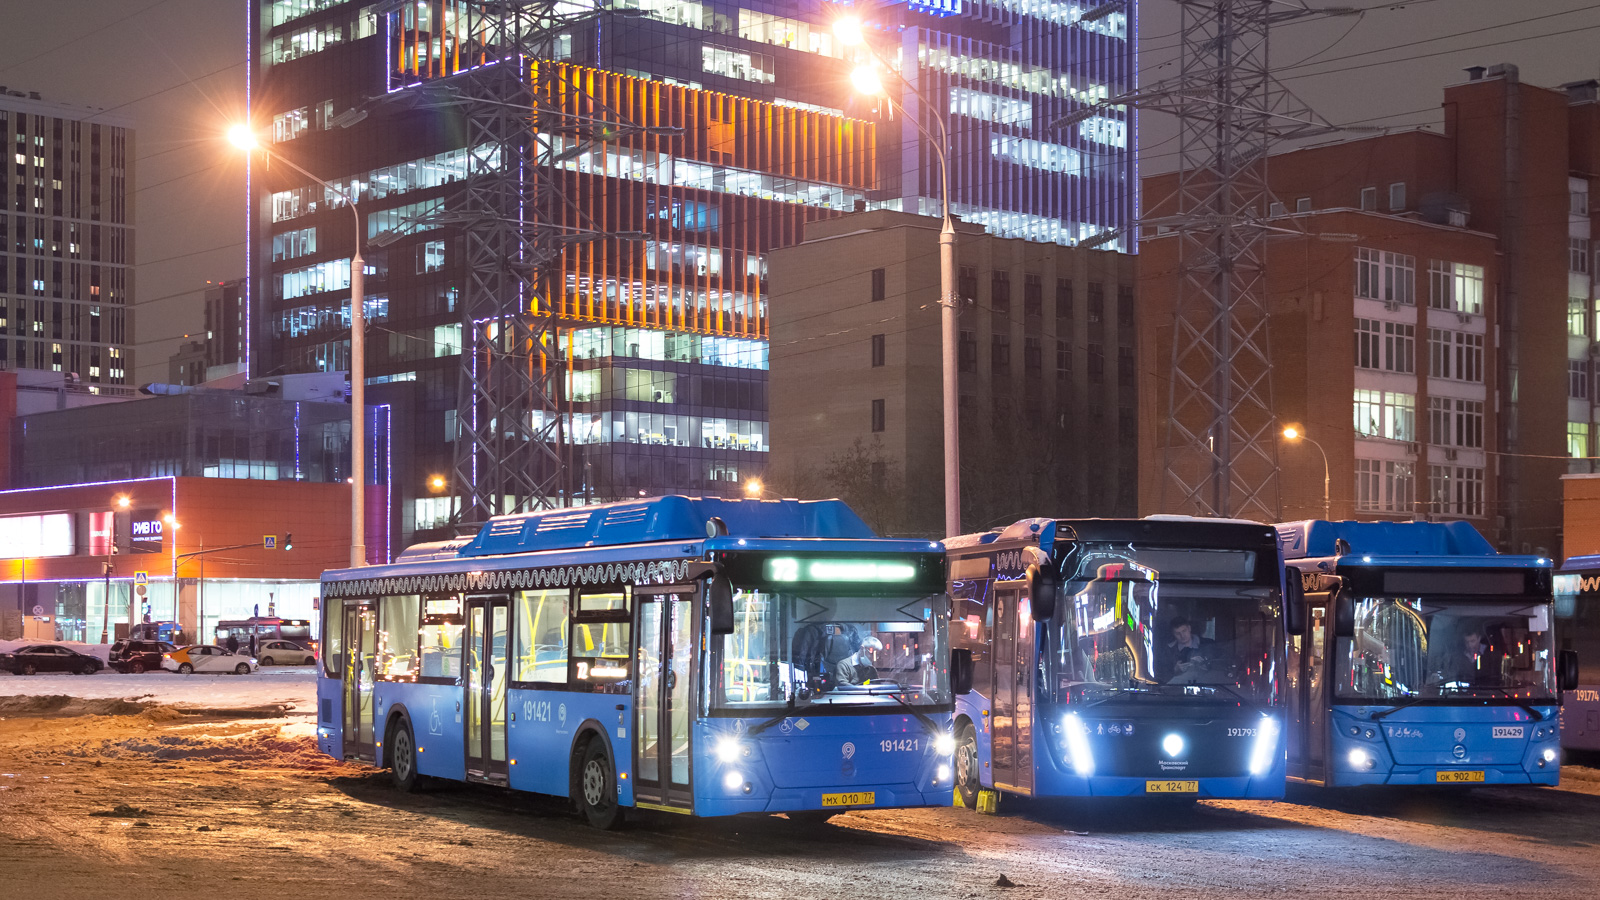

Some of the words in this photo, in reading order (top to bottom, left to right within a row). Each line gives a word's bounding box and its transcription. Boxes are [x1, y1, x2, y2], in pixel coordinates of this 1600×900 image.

[770, 557, 798, 581] 72
[576, 661, 589, 680] 72
[1576, 689, 1600, 701] 191774
[523, 700, 551, 722] 191421
[1227, 727, 1257, 737] 191793
[1493, 728, 1523, 737] 191429
[880, 738, 919, 752] 191421
[1453, 772, 1470, 781] 902
[1166, 781, 1182, 792] 124
[841, 793, 859, 804] 010
